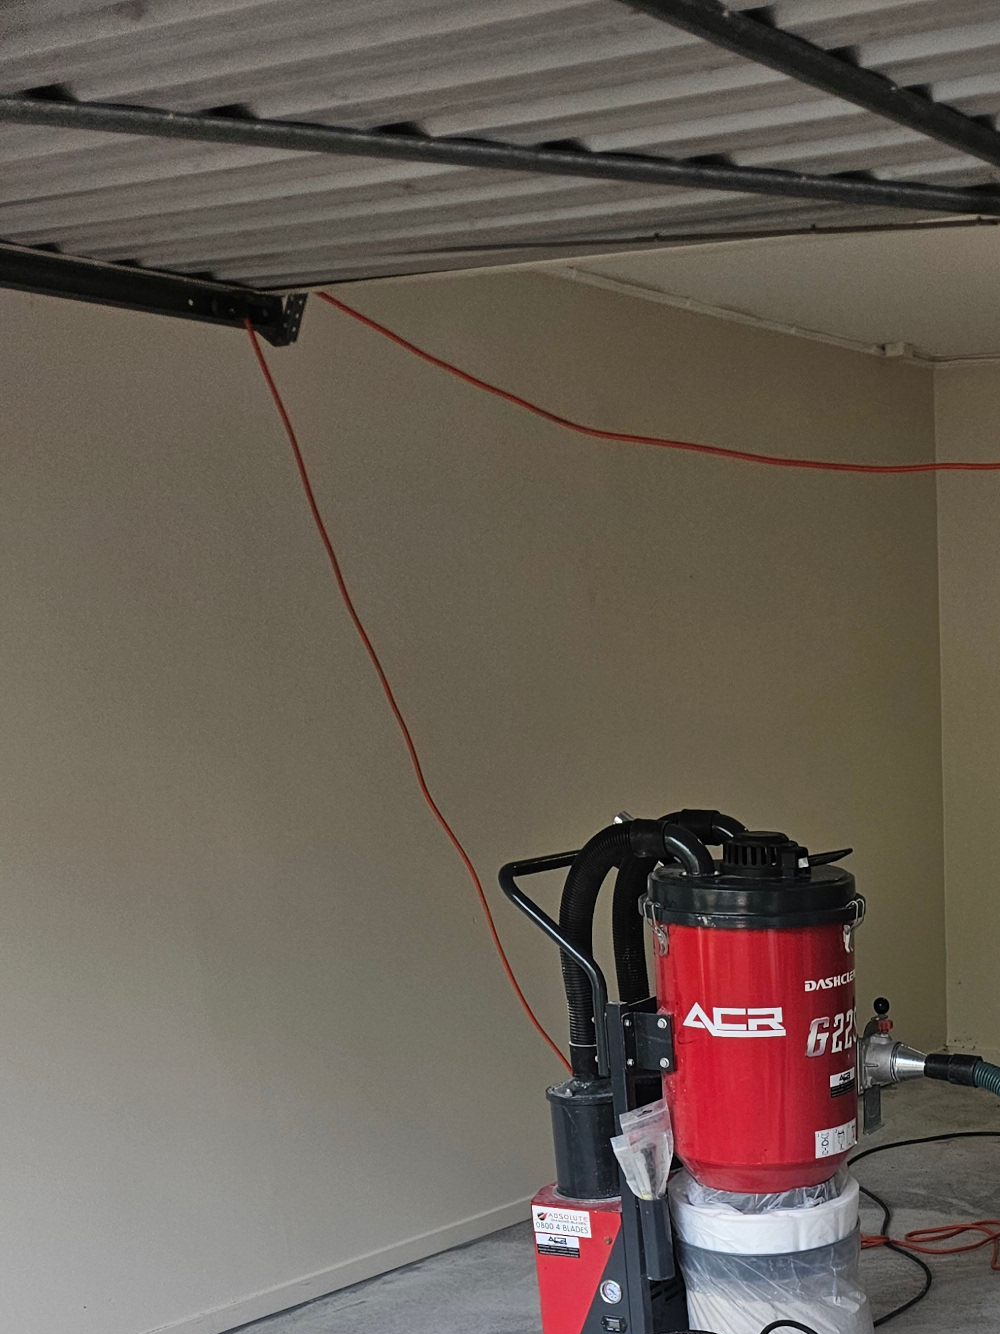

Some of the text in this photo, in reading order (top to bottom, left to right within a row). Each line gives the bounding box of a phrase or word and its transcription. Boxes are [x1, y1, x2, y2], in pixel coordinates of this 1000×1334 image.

[682, 1001, 787, 1038] ACR
[548, 1212, 588, 1222] ABSOLUTE
[535, 1221, 554, 1230] 0800
[562, 1224, 589, 1234] BLADES
